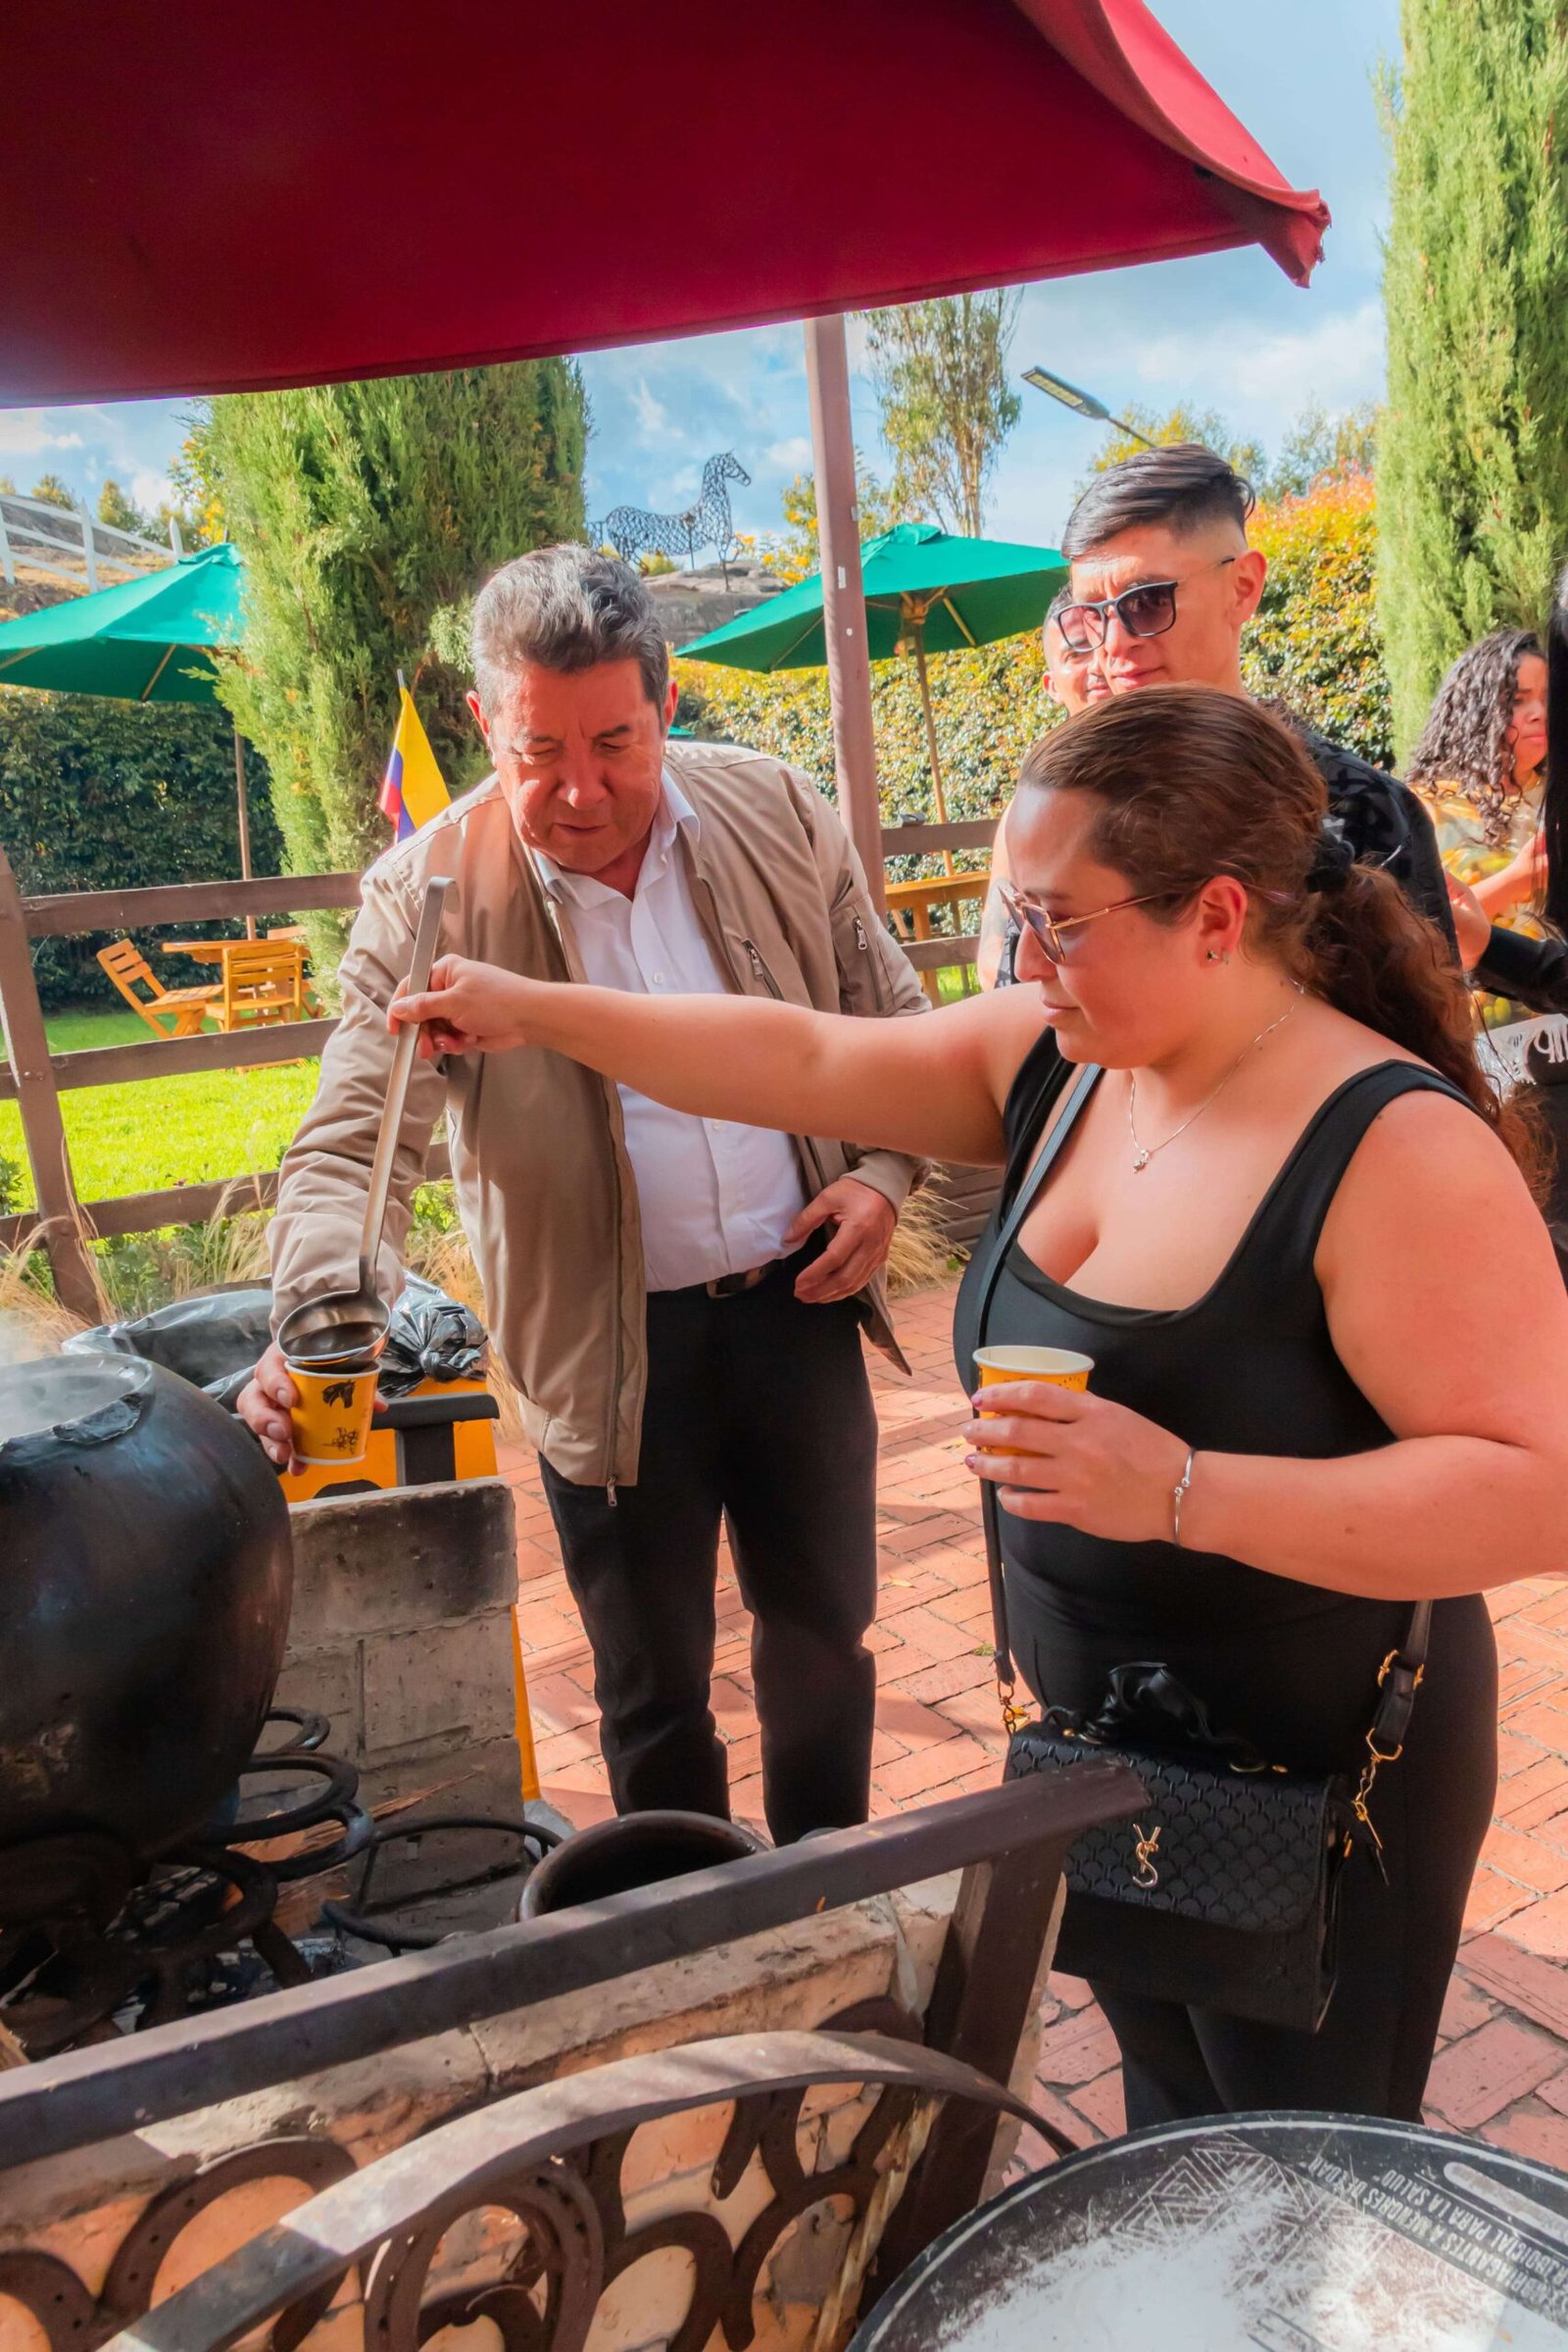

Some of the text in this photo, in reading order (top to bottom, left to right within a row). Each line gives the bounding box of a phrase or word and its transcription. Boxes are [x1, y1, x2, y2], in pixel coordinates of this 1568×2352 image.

[1363, 2188, 1433, 2237] MENORES
[1429, 2193, 1450, 2218] LA
[1429, 2225, 1446, 2243] A
[1448, 2206, 1492, 2243] PARA
